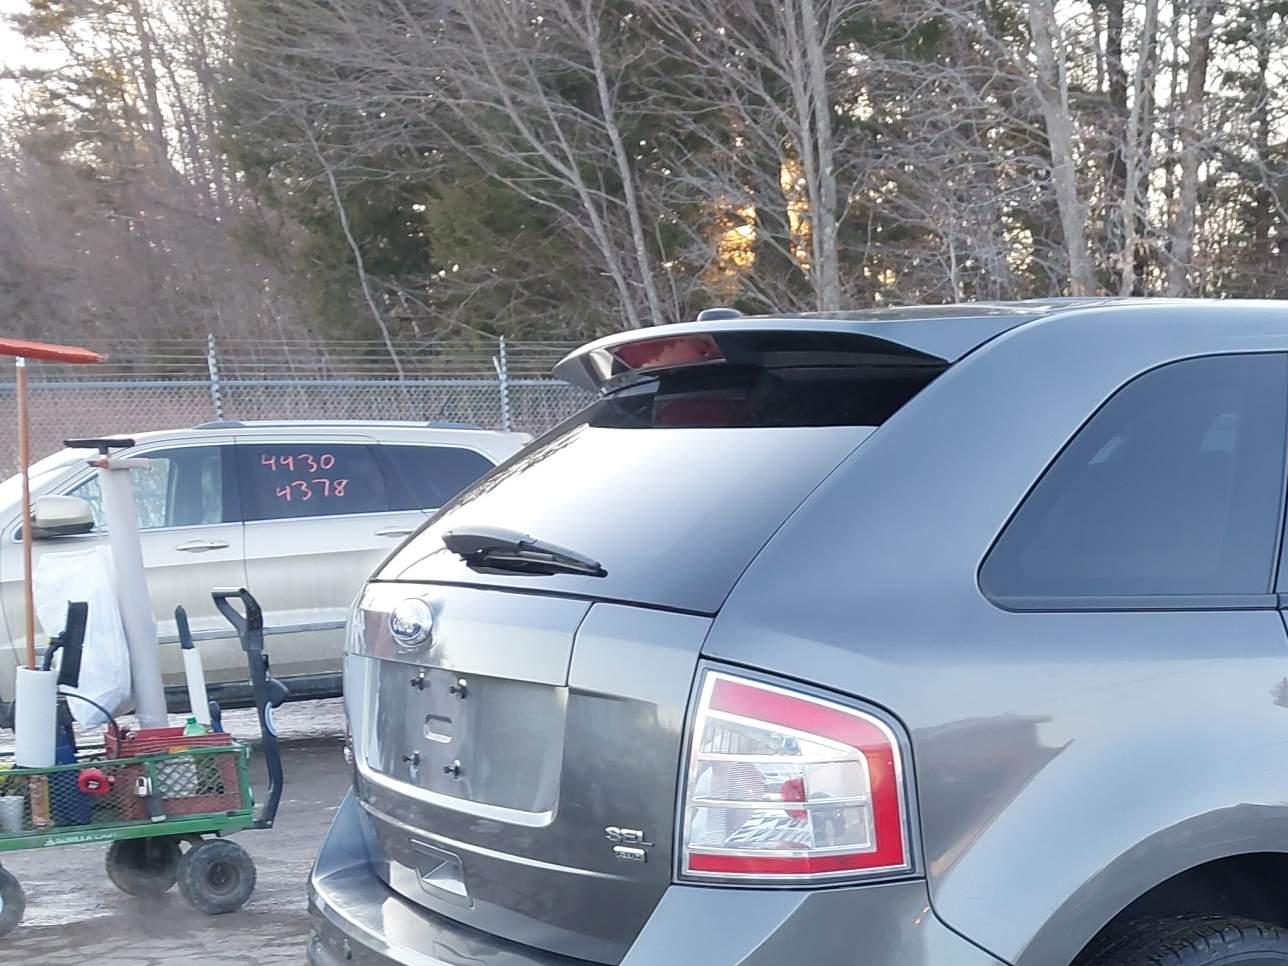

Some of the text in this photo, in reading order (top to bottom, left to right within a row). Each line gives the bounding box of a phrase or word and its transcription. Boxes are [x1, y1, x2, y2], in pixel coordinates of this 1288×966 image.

[261, 453, 335, 472] 4430
[276, 479, 348, 501] 4378
[604, 826, 655, 847] SEL
